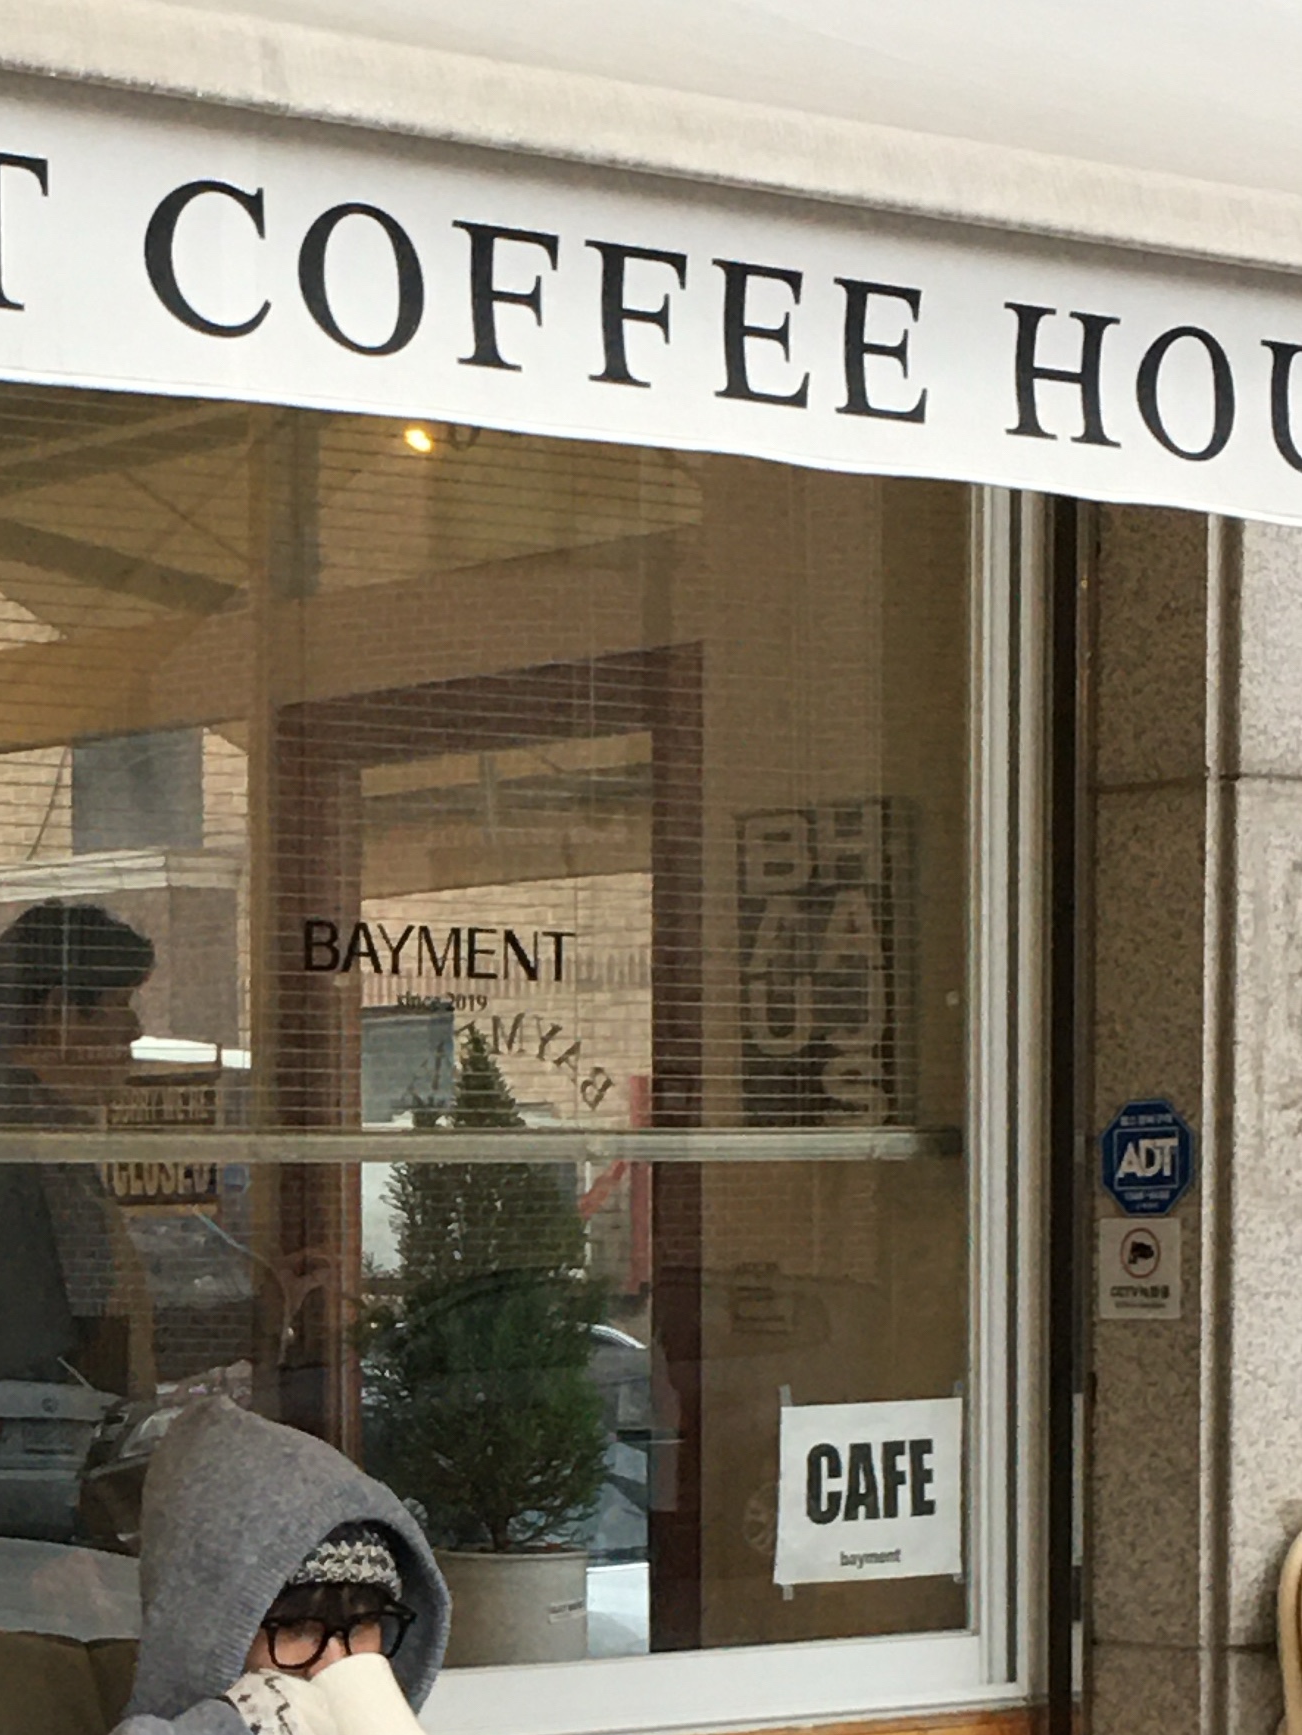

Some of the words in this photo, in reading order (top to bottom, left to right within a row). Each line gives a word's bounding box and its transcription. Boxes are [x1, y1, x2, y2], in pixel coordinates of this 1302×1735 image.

[144, 179, 928, 424] COFFEE
[303, 920, 576, 982] BAYMENT
[445, 991, 488, 1012] 2019
[1116, 1136, 1179, 1178] ADT
[806, 1438, 936, 1525] CAFE
[840, 1548, 901, 1569] bayment
